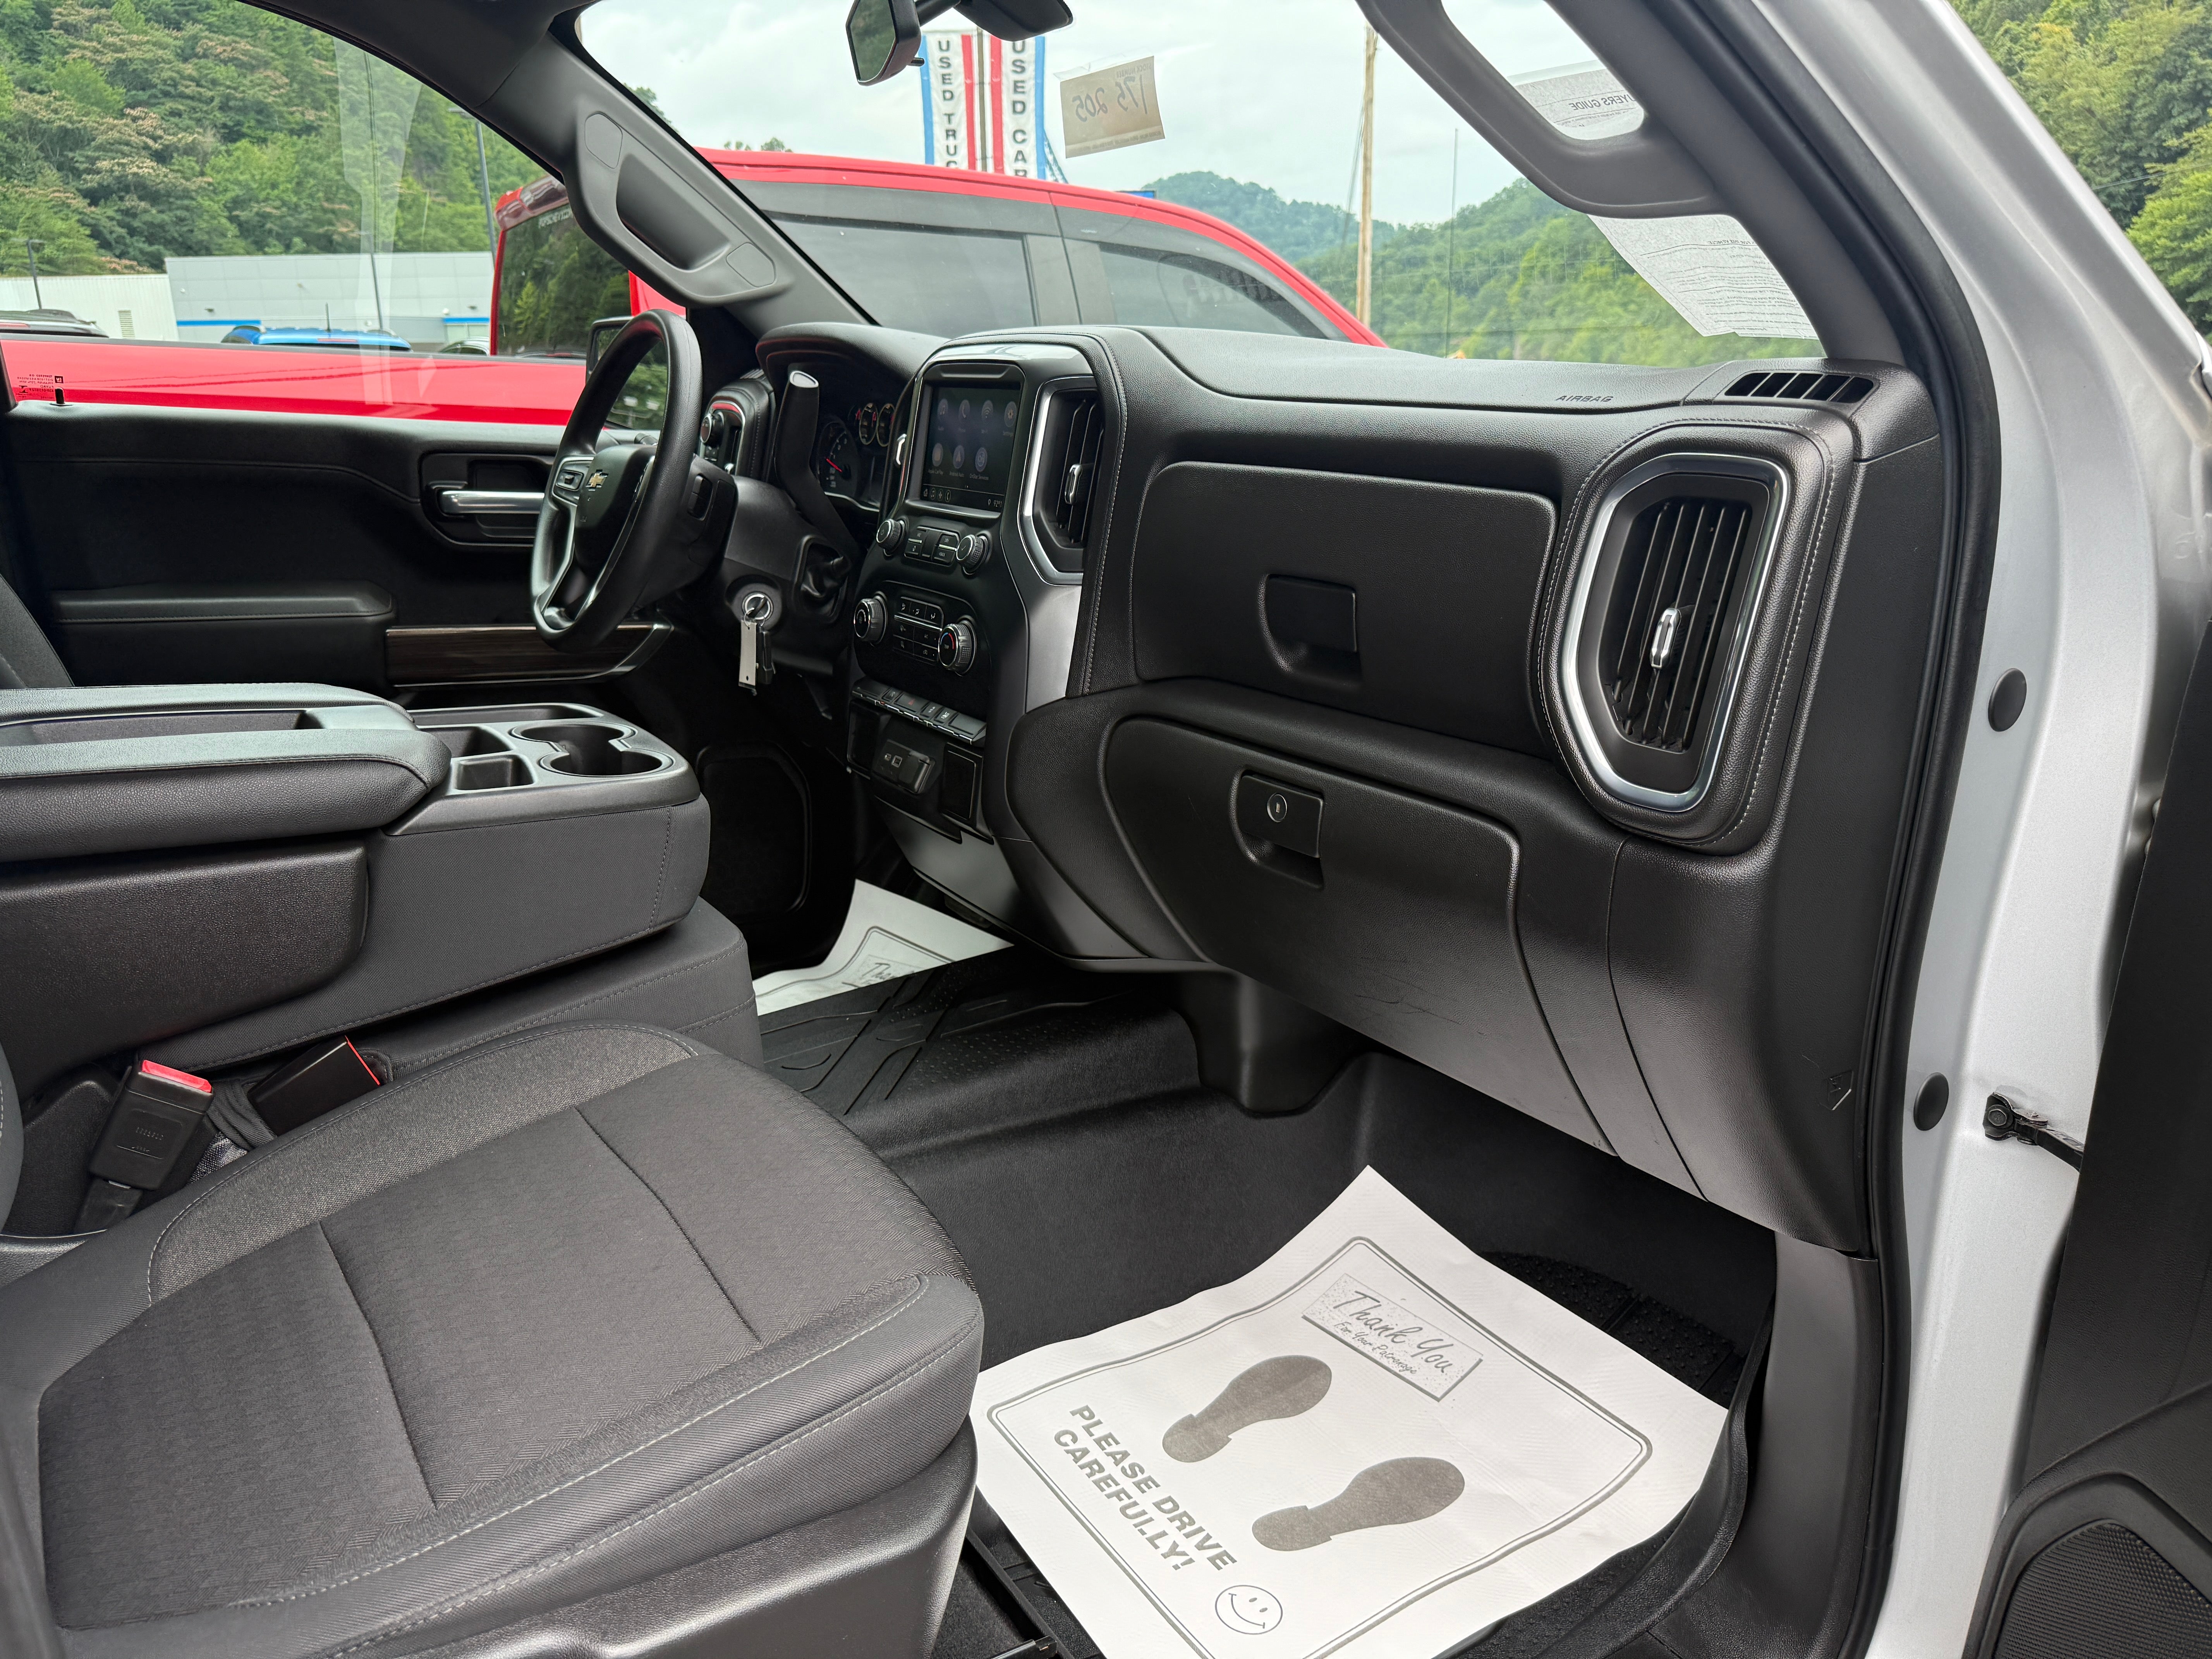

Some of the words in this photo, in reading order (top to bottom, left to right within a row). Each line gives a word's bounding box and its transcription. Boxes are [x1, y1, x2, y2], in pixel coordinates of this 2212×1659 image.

[938, 40, 954, 101] USED
[1012, 41, 1026, 115] USED
[1333, 1290, 1423, 1344] Thank
[1410, 1338, 1454, 1373] You
[1334, 1321, 1352, 1334] For
[1352, 1331, 1372, 1346] Your
[1371, 1344, 1419, 1374] Patronage
[1054, 1429, 1195, 1571] CAREFULLY!
[1069, 1405, 1161, 1494] PLEASE
[1152, 1495, 1238, 1571] DRIVE
